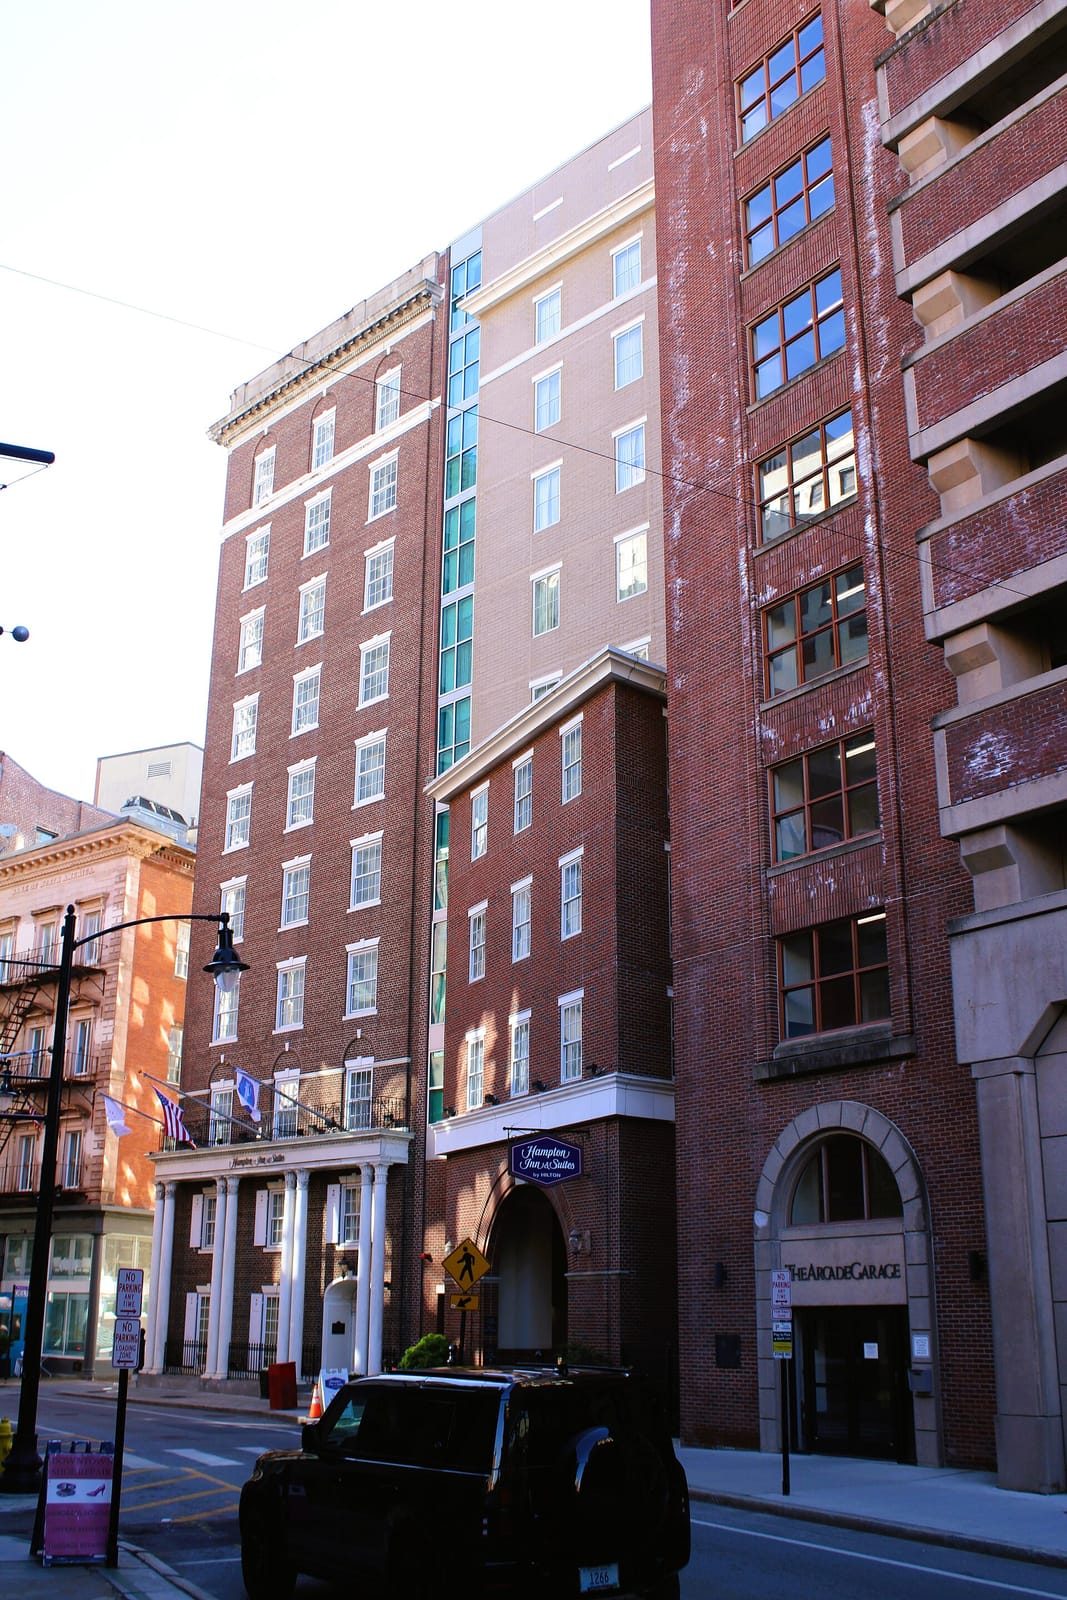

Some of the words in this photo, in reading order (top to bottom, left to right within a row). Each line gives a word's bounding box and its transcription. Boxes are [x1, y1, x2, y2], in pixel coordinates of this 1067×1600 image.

[521, 1145, 570, 1159] Hampton
[520, 1159, 544, 1170] Inn
[544, 1162, 550, 1170] &
[550, 1159, 575, 1170] Suites
[126, 1272, 136, 1282] NO
[777, 1272, 786, 1281] NO
[118, 1283, 142, 1293] PARKING
[772, 1281, 791, 1289] PARKING
[122, 1322, 133, 1332] NO
[116, 1333, 138, 1343] PARKING
[590, 1572, 609, 1585] 1266
